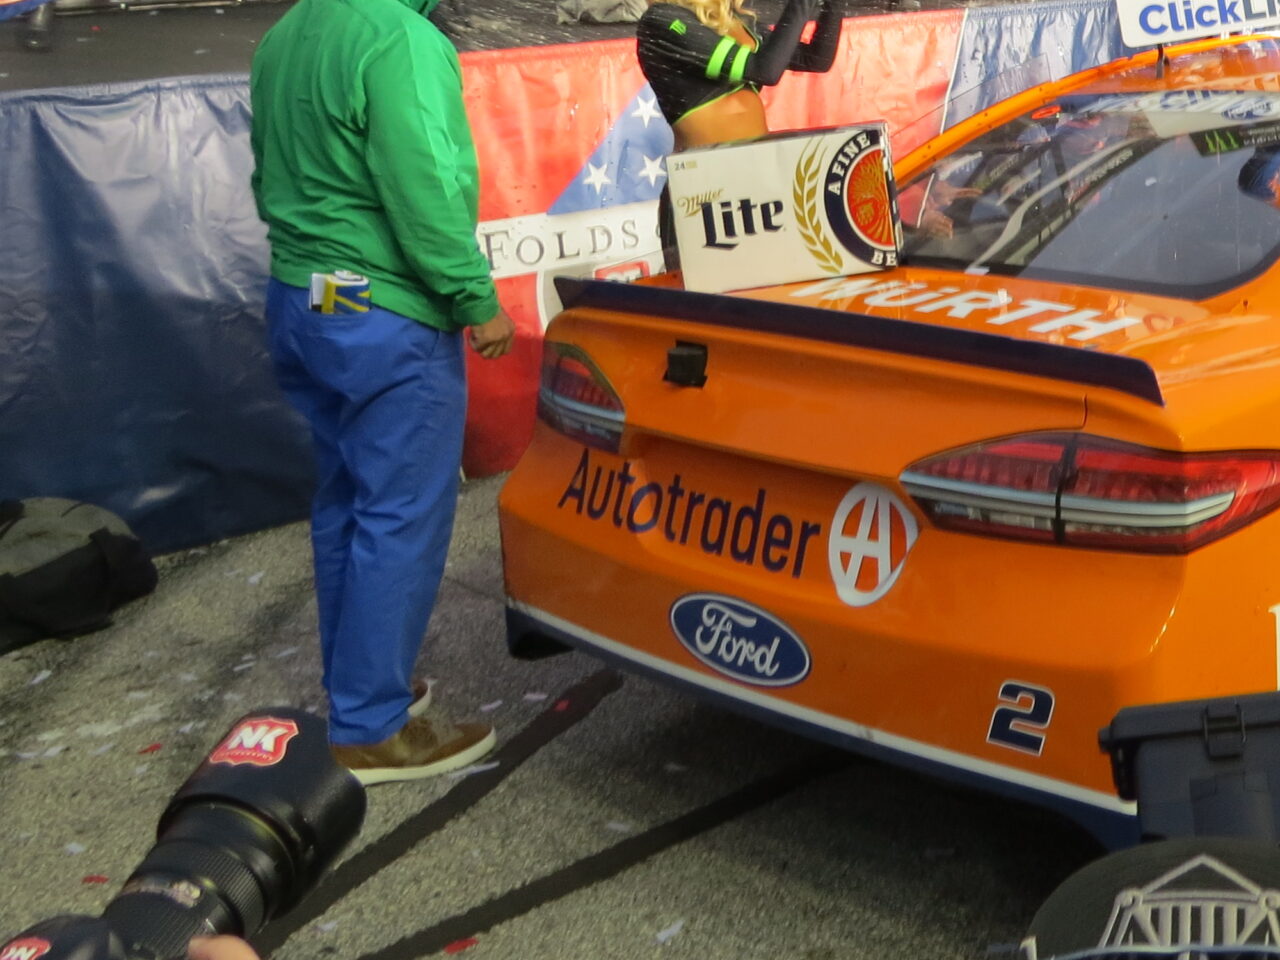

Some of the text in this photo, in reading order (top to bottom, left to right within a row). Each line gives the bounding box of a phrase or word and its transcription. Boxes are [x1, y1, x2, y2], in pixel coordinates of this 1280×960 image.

[828, 133, 871, 196] A FINE
[676, 187, 725, 218] Miller
[700, 198, 784, 251] Lite
[480, 218, 640, 271] FOLDS
[558, 447, 822, 579] Autotrader
[695, 600, 781, 678] Ford
[986, 679, 1056, 757] 2
